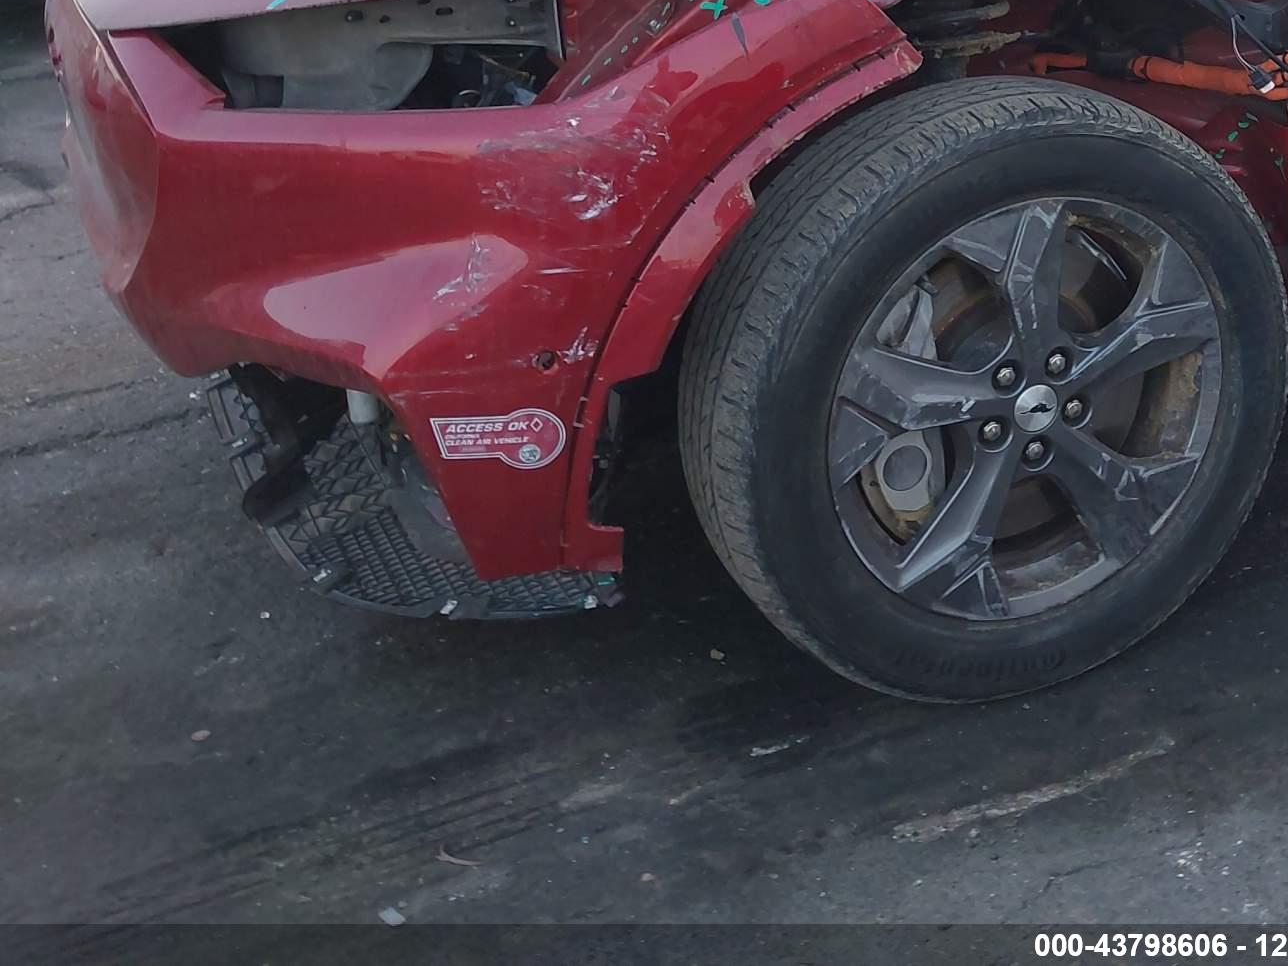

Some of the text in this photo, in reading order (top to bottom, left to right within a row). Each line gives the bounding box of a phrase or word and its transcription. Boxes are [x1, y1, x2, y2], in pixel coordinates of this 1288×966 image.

[445, 420, 530, 433] ACCESS OK
[494, 436, 530, 445] VEHICLE
